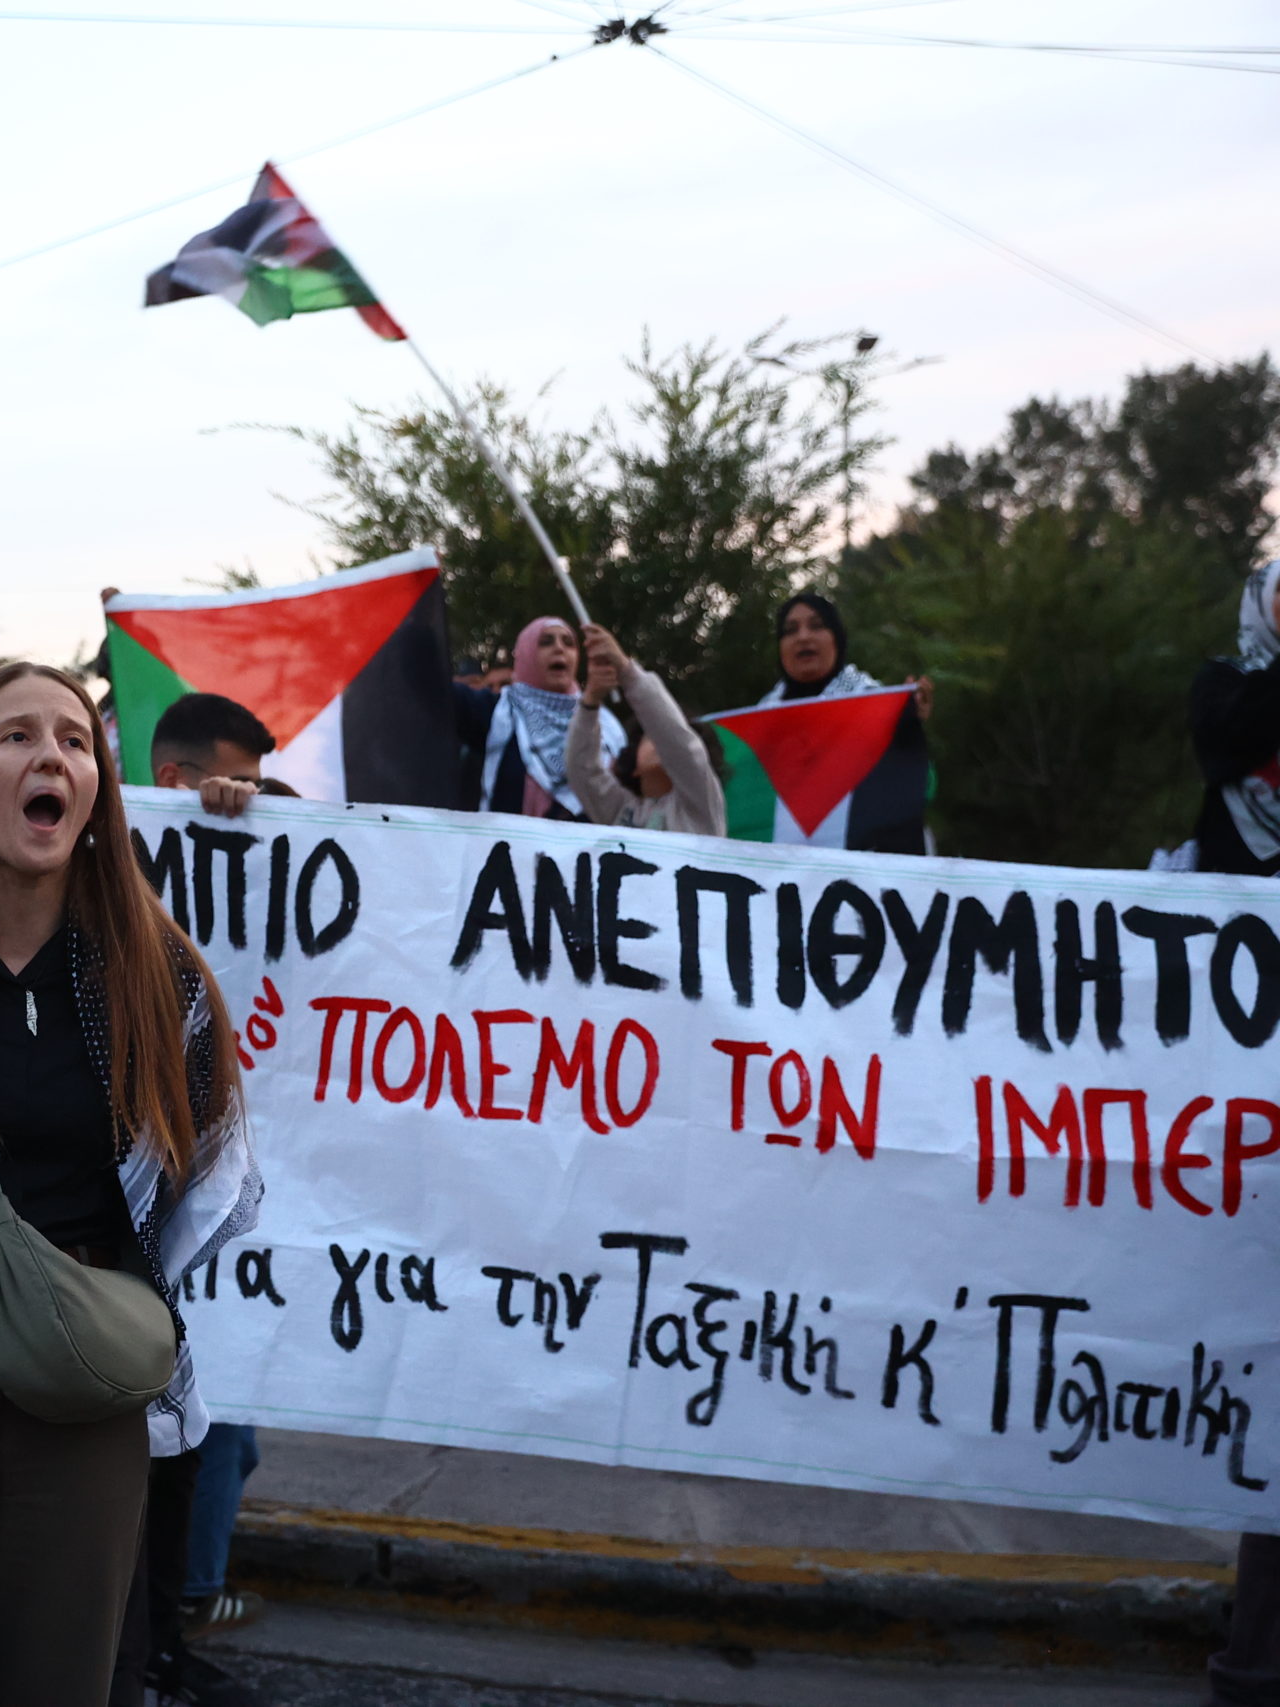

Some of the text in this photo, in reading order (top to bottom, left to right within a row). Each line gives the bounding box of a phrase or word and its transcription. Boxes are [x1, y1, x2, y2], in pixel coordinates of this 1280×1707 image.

[130, 821, 361, 963] ΜΠΙΟ
[449, 841, 1280, 1053] ΑΝΕΠΙΘΥΜΗΤΟ
[310, 996, 660, 1135] ΠΟΛΕΜΟ
[329, 1242, 450, 1352] για
[480, 1265, 602, 1353] την
